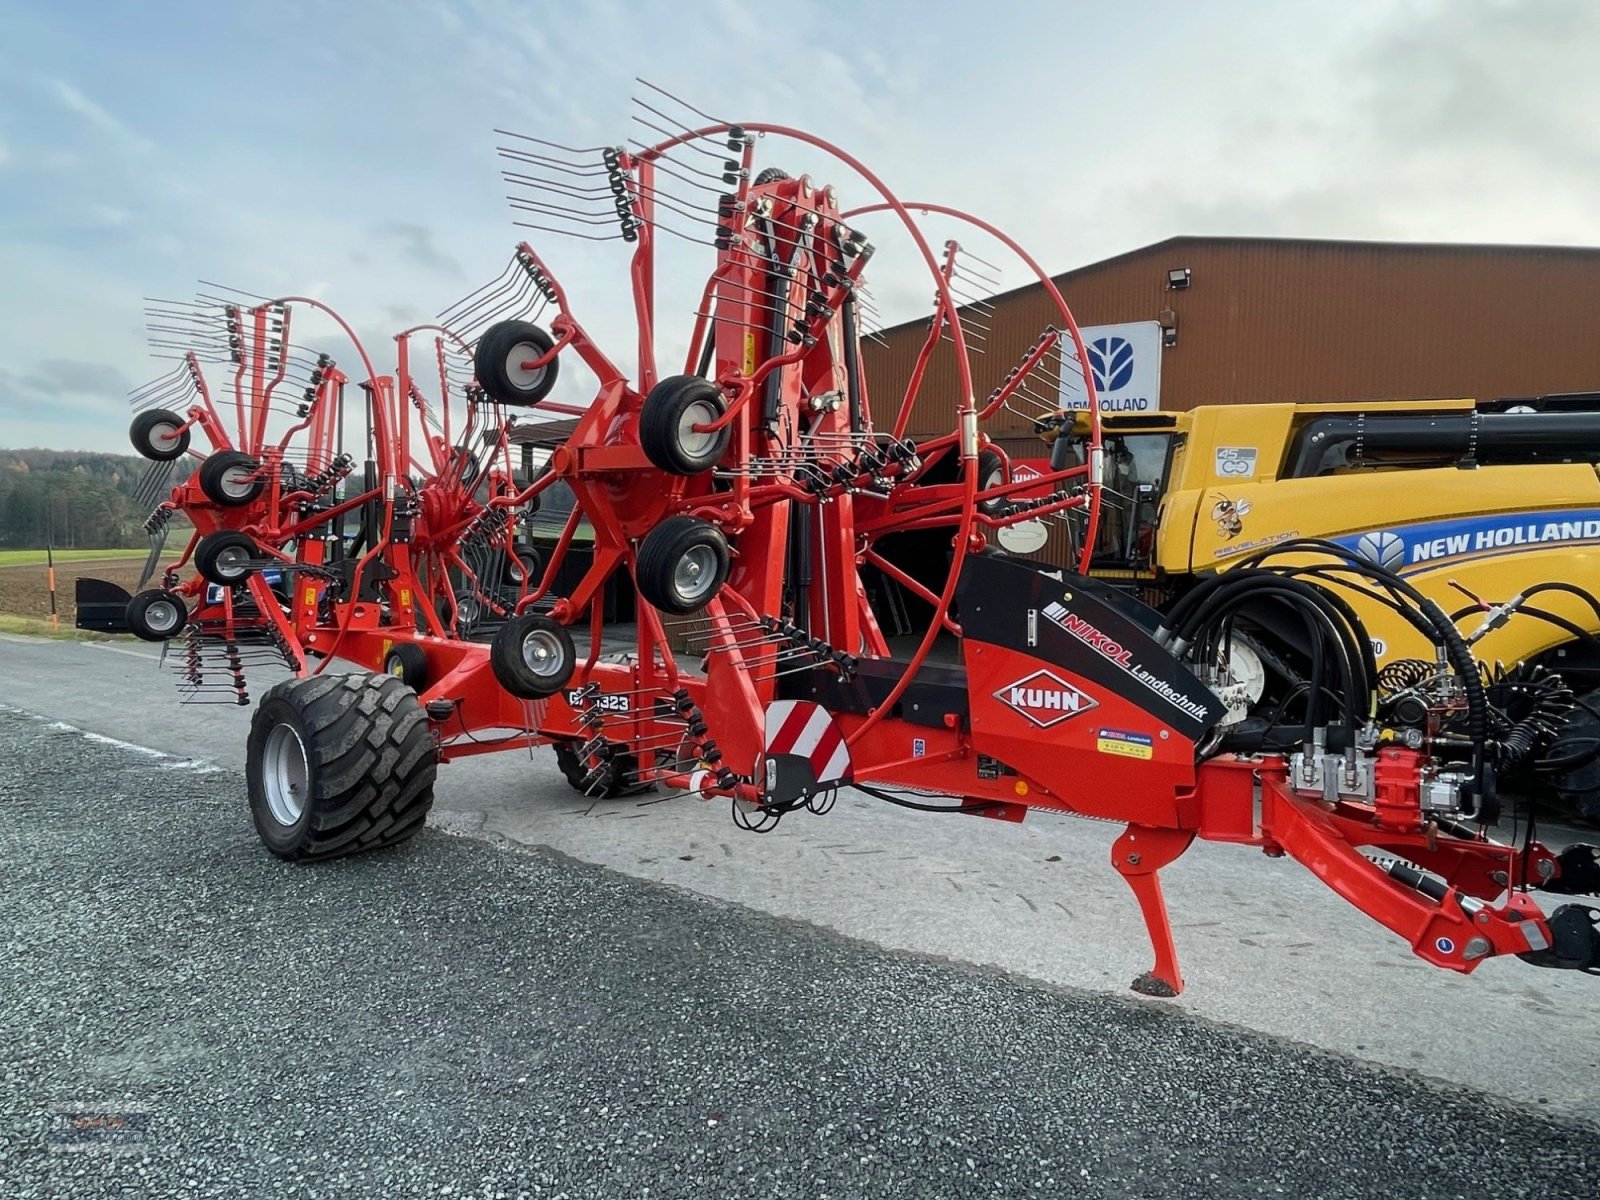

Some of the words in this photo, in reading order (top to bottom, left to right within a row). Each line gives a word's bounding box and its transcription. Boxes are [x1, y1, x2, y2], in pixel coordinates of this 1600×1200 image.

[1218, 448, 1239, 460] 45
[1412, 534, 1470, 563] NEW
[1475, 520, 1600, 550] HOLLAND
[1061, 613, 1133, 668] NIKOL
[1131, 664, 1208, 719] Landtechnik
[1011, 687, 1080, 712] KUHN
